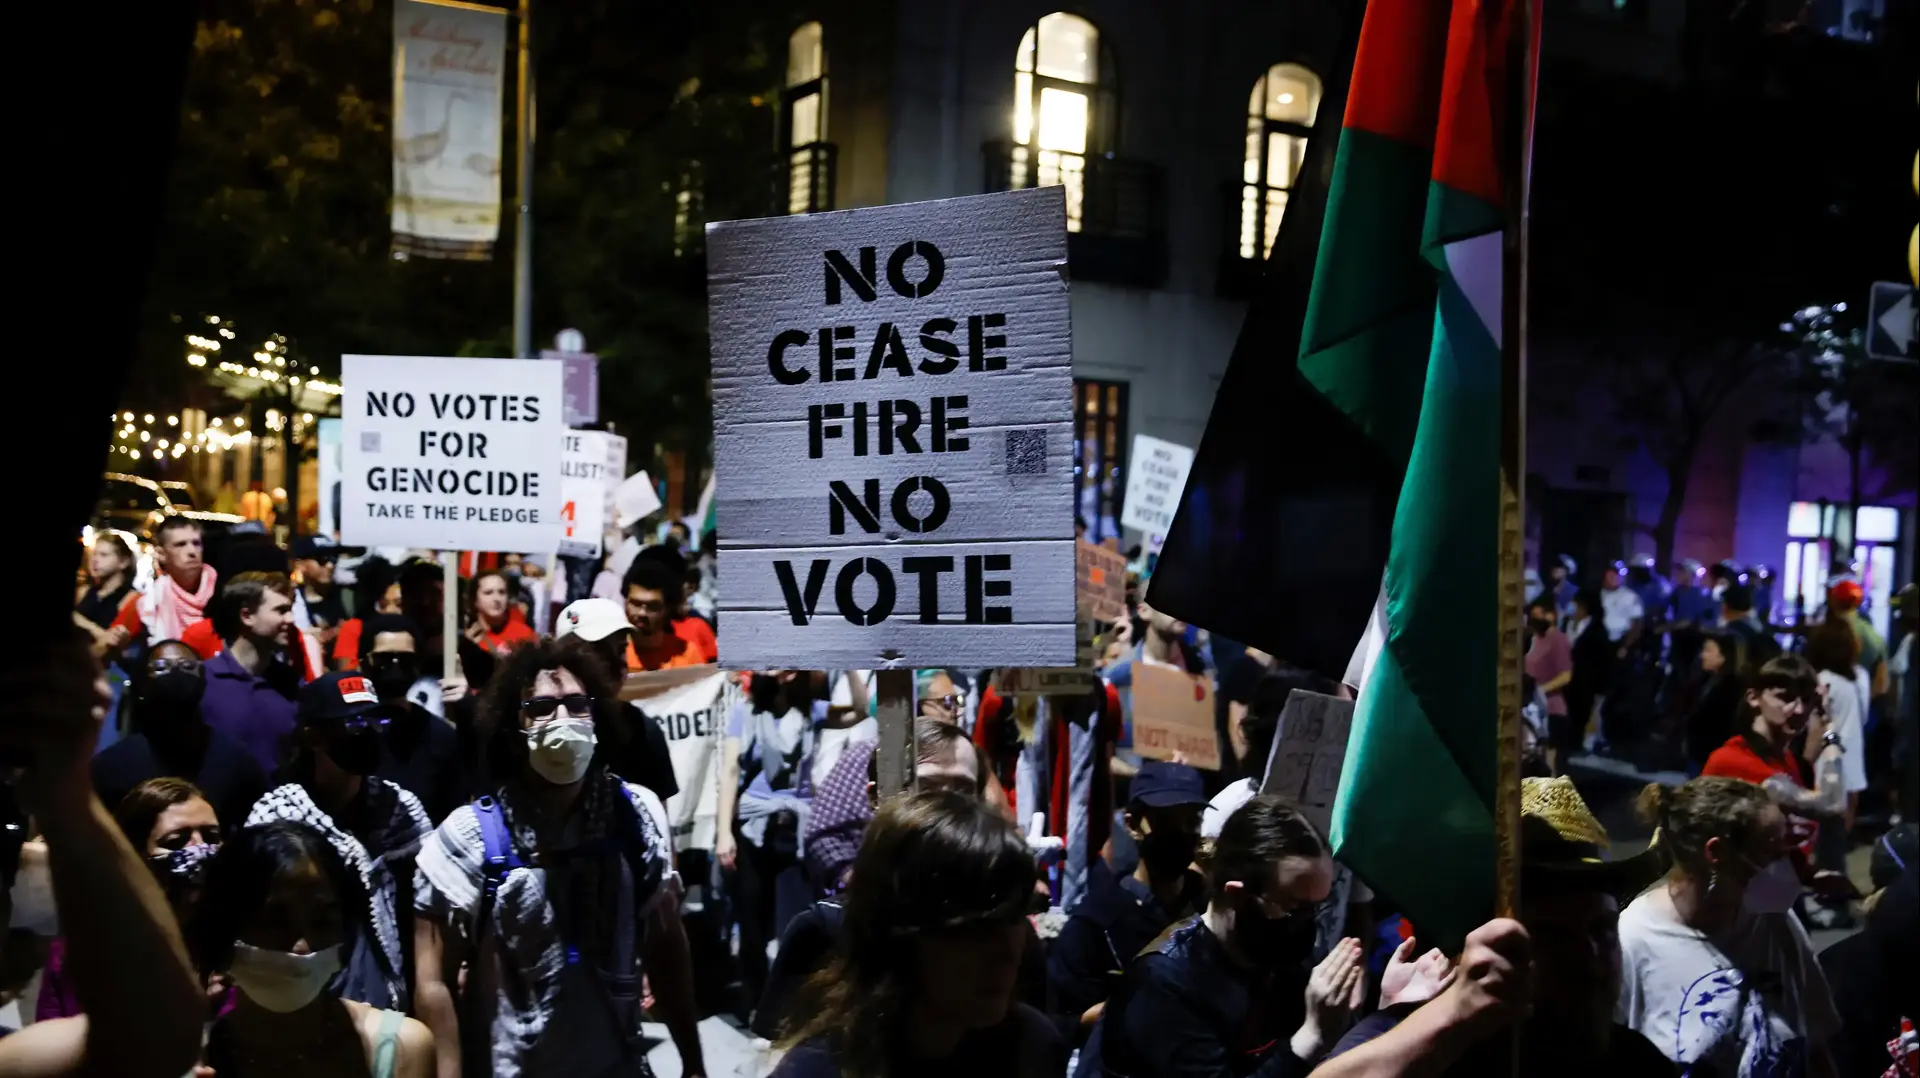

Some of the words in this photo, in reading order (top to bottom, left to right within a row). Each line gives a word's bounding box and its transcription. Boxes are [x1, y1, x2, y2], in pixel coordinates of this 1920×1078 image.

[824, 240, 945, 305] NO
[767, 313, 1007, 385] CEASE
[366, 391, 415, 418] NO
[430, 393, 541, 422] VOTES
[808, 395, 970, 459] FIRE
[419, 430, 488, 459] FOR
[366, 466, 540, 498] GENOCIDE
[829, 476, 950, 535] NO
[366, 503, 415, 519] TAKE
[422, 505, 459, 521] THE
[465, 507, 540, 524] PLEDGE
[773, 554, 1013, 627] VOTE
